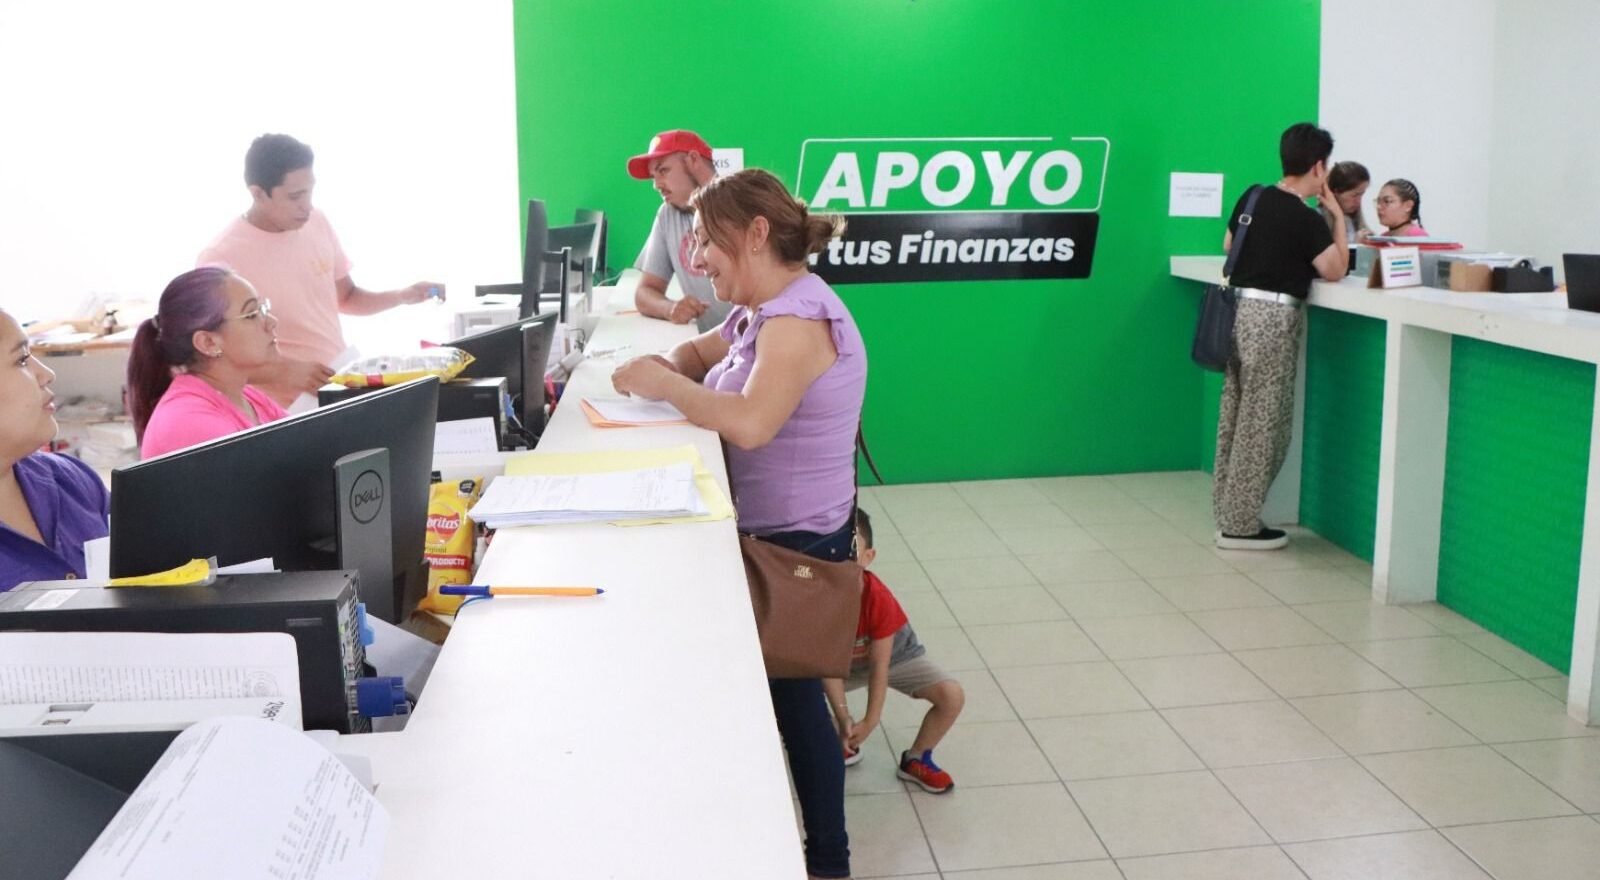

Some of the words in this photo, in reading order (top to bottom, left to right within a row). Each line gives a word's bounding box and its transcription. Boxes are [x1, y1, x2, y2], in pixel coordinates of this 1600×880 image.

[809, 150, 1082, 208] APOYO
[827, 235, 892, 265] tus
[898, 230, 1075, 264] Finanzas
[354, 487, 381, 508] DELL
